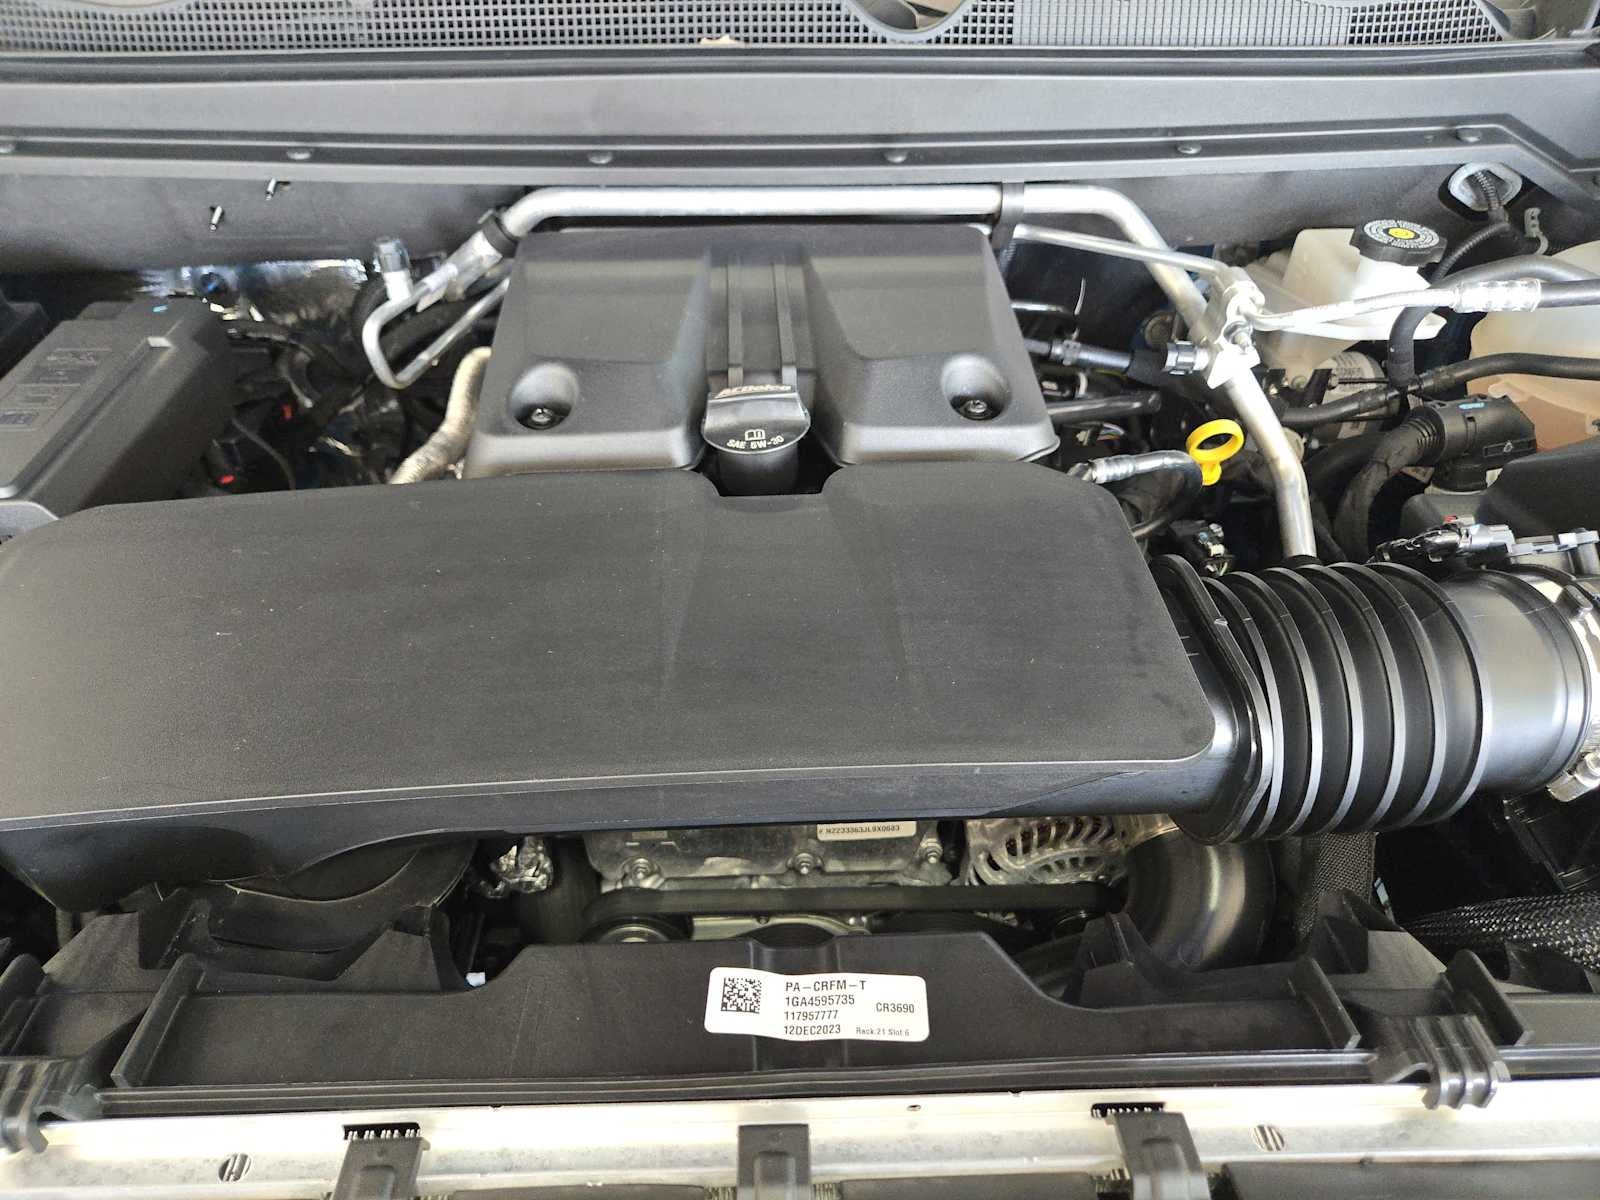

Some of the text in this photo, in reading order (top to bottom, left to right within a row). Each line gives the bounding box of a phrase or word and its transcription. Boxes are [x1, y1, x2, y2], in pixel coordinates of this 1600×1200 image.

[726, 439, 746, 450] SAE
[785, 994, 855, 1006] 1GA4595735
[875, 1002, 915, 1013] CR3690
[784, 1009, 839, 1021] 117957777
[784, 1023, 841, 1035] 12DEC2023
